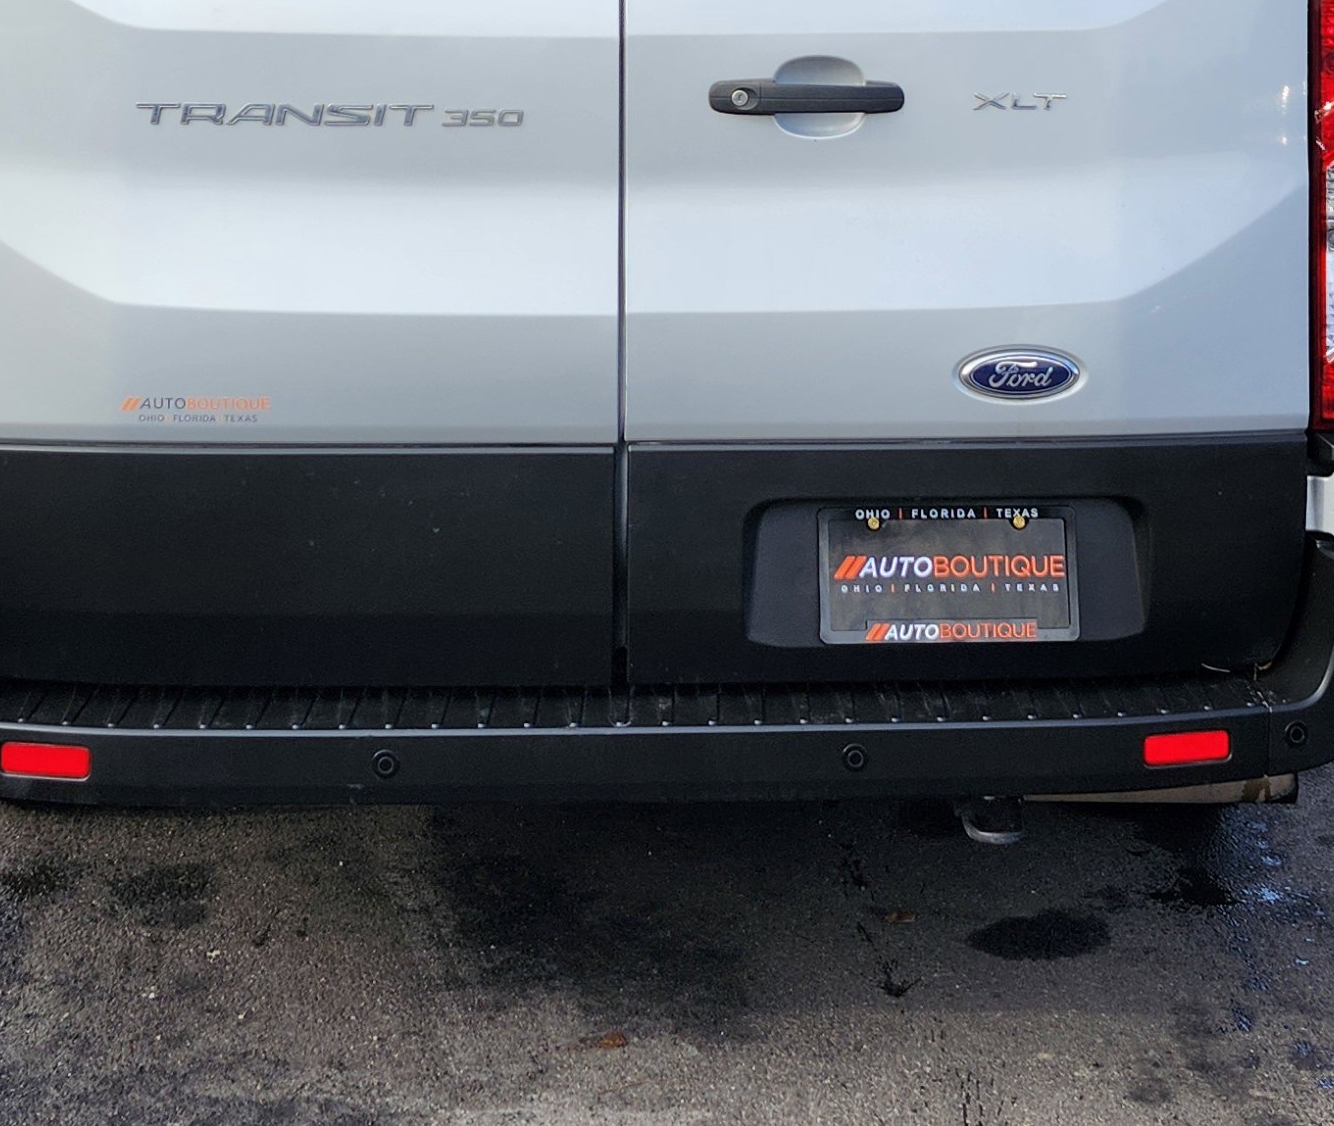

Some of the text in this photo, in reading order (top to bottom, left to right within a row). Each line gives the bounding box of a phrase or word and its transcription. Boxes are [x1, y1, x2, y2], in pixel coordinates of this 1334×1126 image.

[973, 92, 1068, 111] XLT
[135, 102, 525, 128] TRANSIT 350
[988, 360, 1054, 388] Ford
[139, 396, 272, 411] AUTOBOUTIQUE
[139, 414, 259, 423] OHIO FLORIDA TEXAS
[855, 507, 1039, 520] OHIO FLORIDA TEXAS
[858, 555, 1066, 578] AUTOBOUTIQUE
[840, 583, 1059, 593] OHIO FLORIDA TEXAS
[884, 622, 1038, 640] AUTOBOUTIQUE
